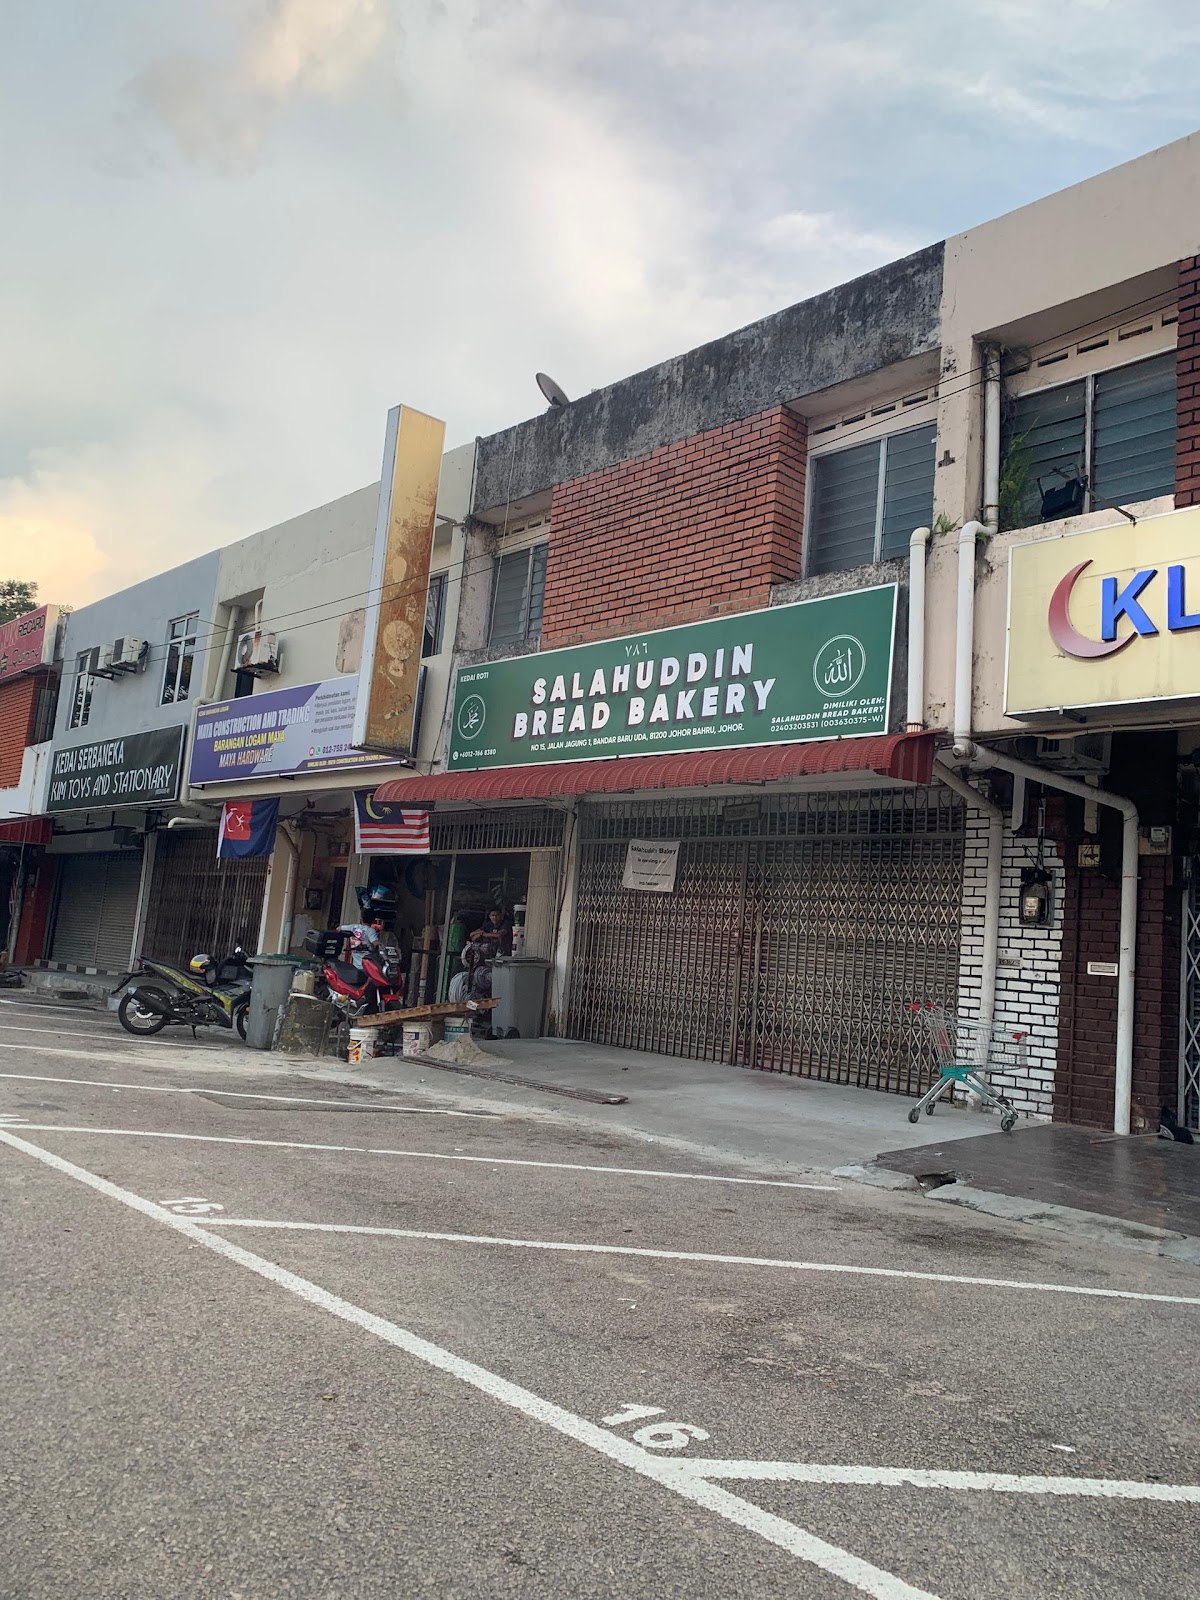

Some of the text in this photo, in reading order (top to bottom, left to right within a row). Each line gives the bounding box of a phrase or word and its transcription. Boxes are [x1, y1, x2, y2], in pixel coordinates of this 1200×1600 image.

[18, 614, 46, 637] RECARO
[460, 671, 489, 683] KEDAI ROTI
[532, 643, 753, 705] SALAHUDDIN
[512, 677, 777, 738] BREAD BAKERY
[771, 705, 885, 724] SALAHUDDIN BREAD BAKERY
[823, 697, 885, 710] DIMILIKI OLEH:
[197, 722, 213, 740] MAYA
[213, 714, 262, 738] CONSTRUCTION
[262, 710, 279, 729] AND
[278, 705, 310, 727] TRADING
[770, 714, 884, 732] 02403203531 (003630375-W)
[213, 729, 285, 752] BARANGAN LOGAM MAYA
[547, 741, 563, 750] JALAN
[564, 739, 587, 748] JAGUNG
[593, 736, 616, 745] BANDAR
[617, 734, 632, 743] BARU
[634, 732, 648, 741] UDA,
[649, 730, 667, 740] 81200
[668, 728, 691, 738] JOHOR
[692, 725, 716, 736] BAHRU,
[718, 723, 745, 733] JOHOR.
[55, 741, 124, 774] KEDAI SERBANEKA
[219, 747, 273, 768] MAYA HARDWARE
[51, 764, 174, 801] KIM TOYS AND STATIONARY
[600, 1403, 711, 1450] 16
